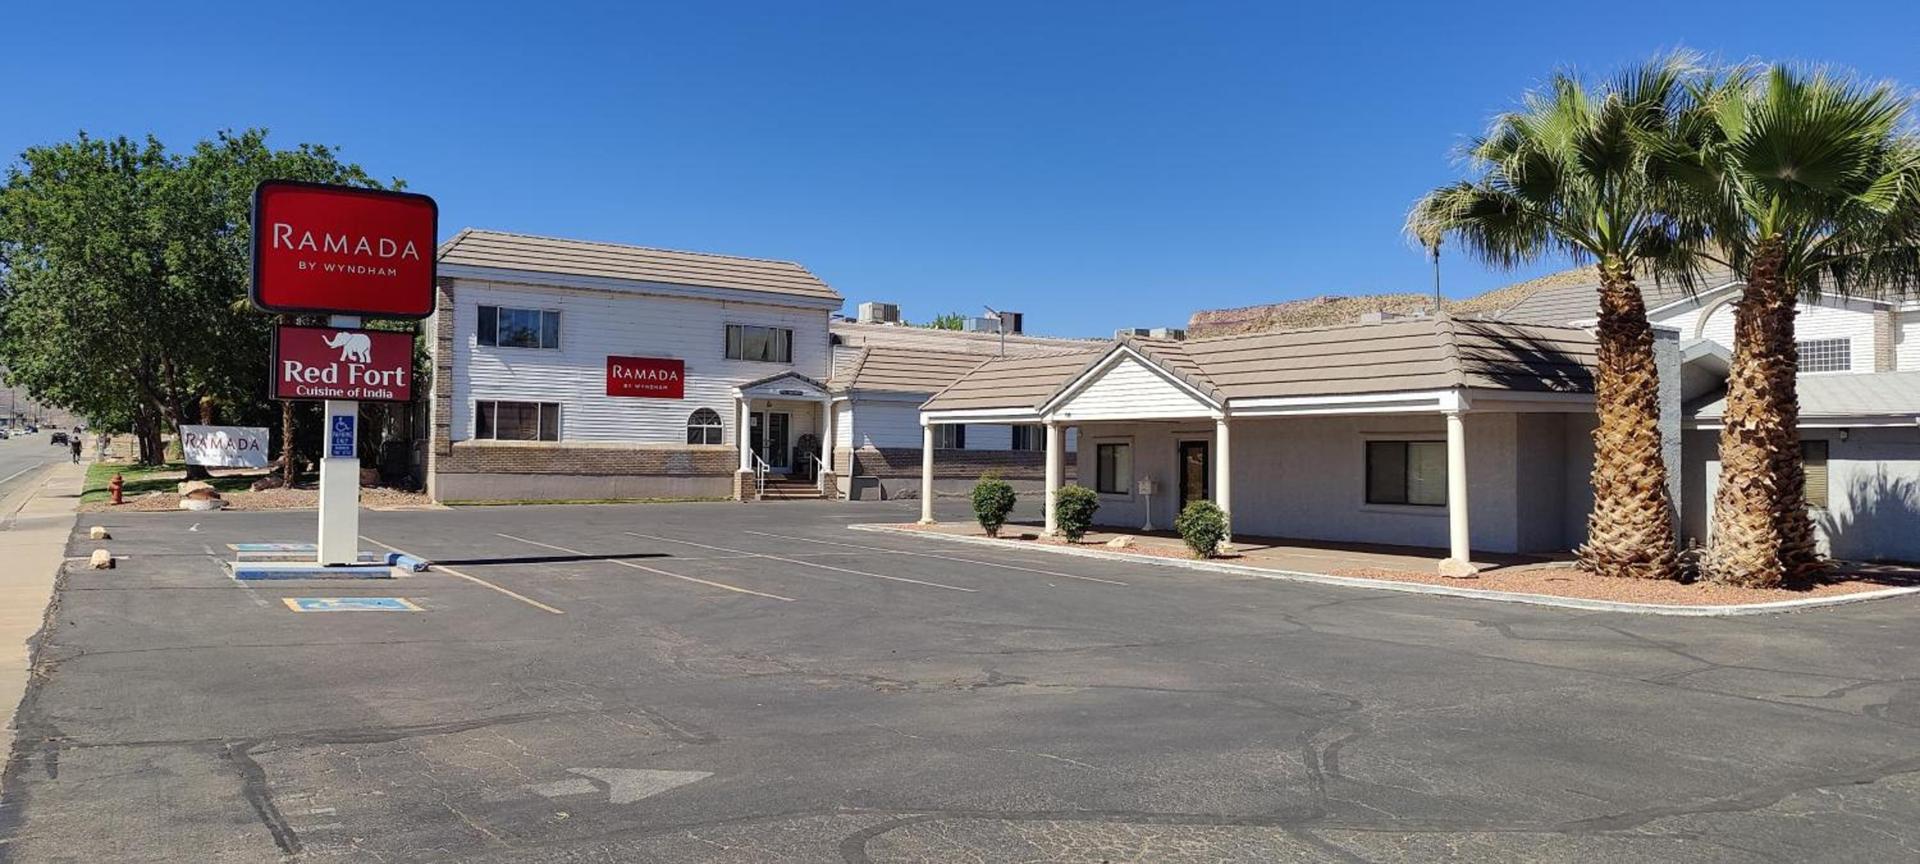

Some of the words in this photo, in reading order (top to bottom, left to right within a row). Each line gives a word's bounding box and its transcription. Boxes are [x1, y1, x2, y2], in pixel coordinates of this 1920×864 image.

[273, 222, 420, 261] RAMADA
[298, 260, 317, 271] BY
[323, 262, 397, 277] WYNDHAM
[283, 360, 338, 384] Red
[347, 363, 406, 387] Fort
[612, 364, 678, 381] RAMADA
[296, 385, 344, 397] Cuisine
[347, 387, 361, 397] of
[363, 387, 393, 399] India
[185, 432, 260, 451] RAMADA
